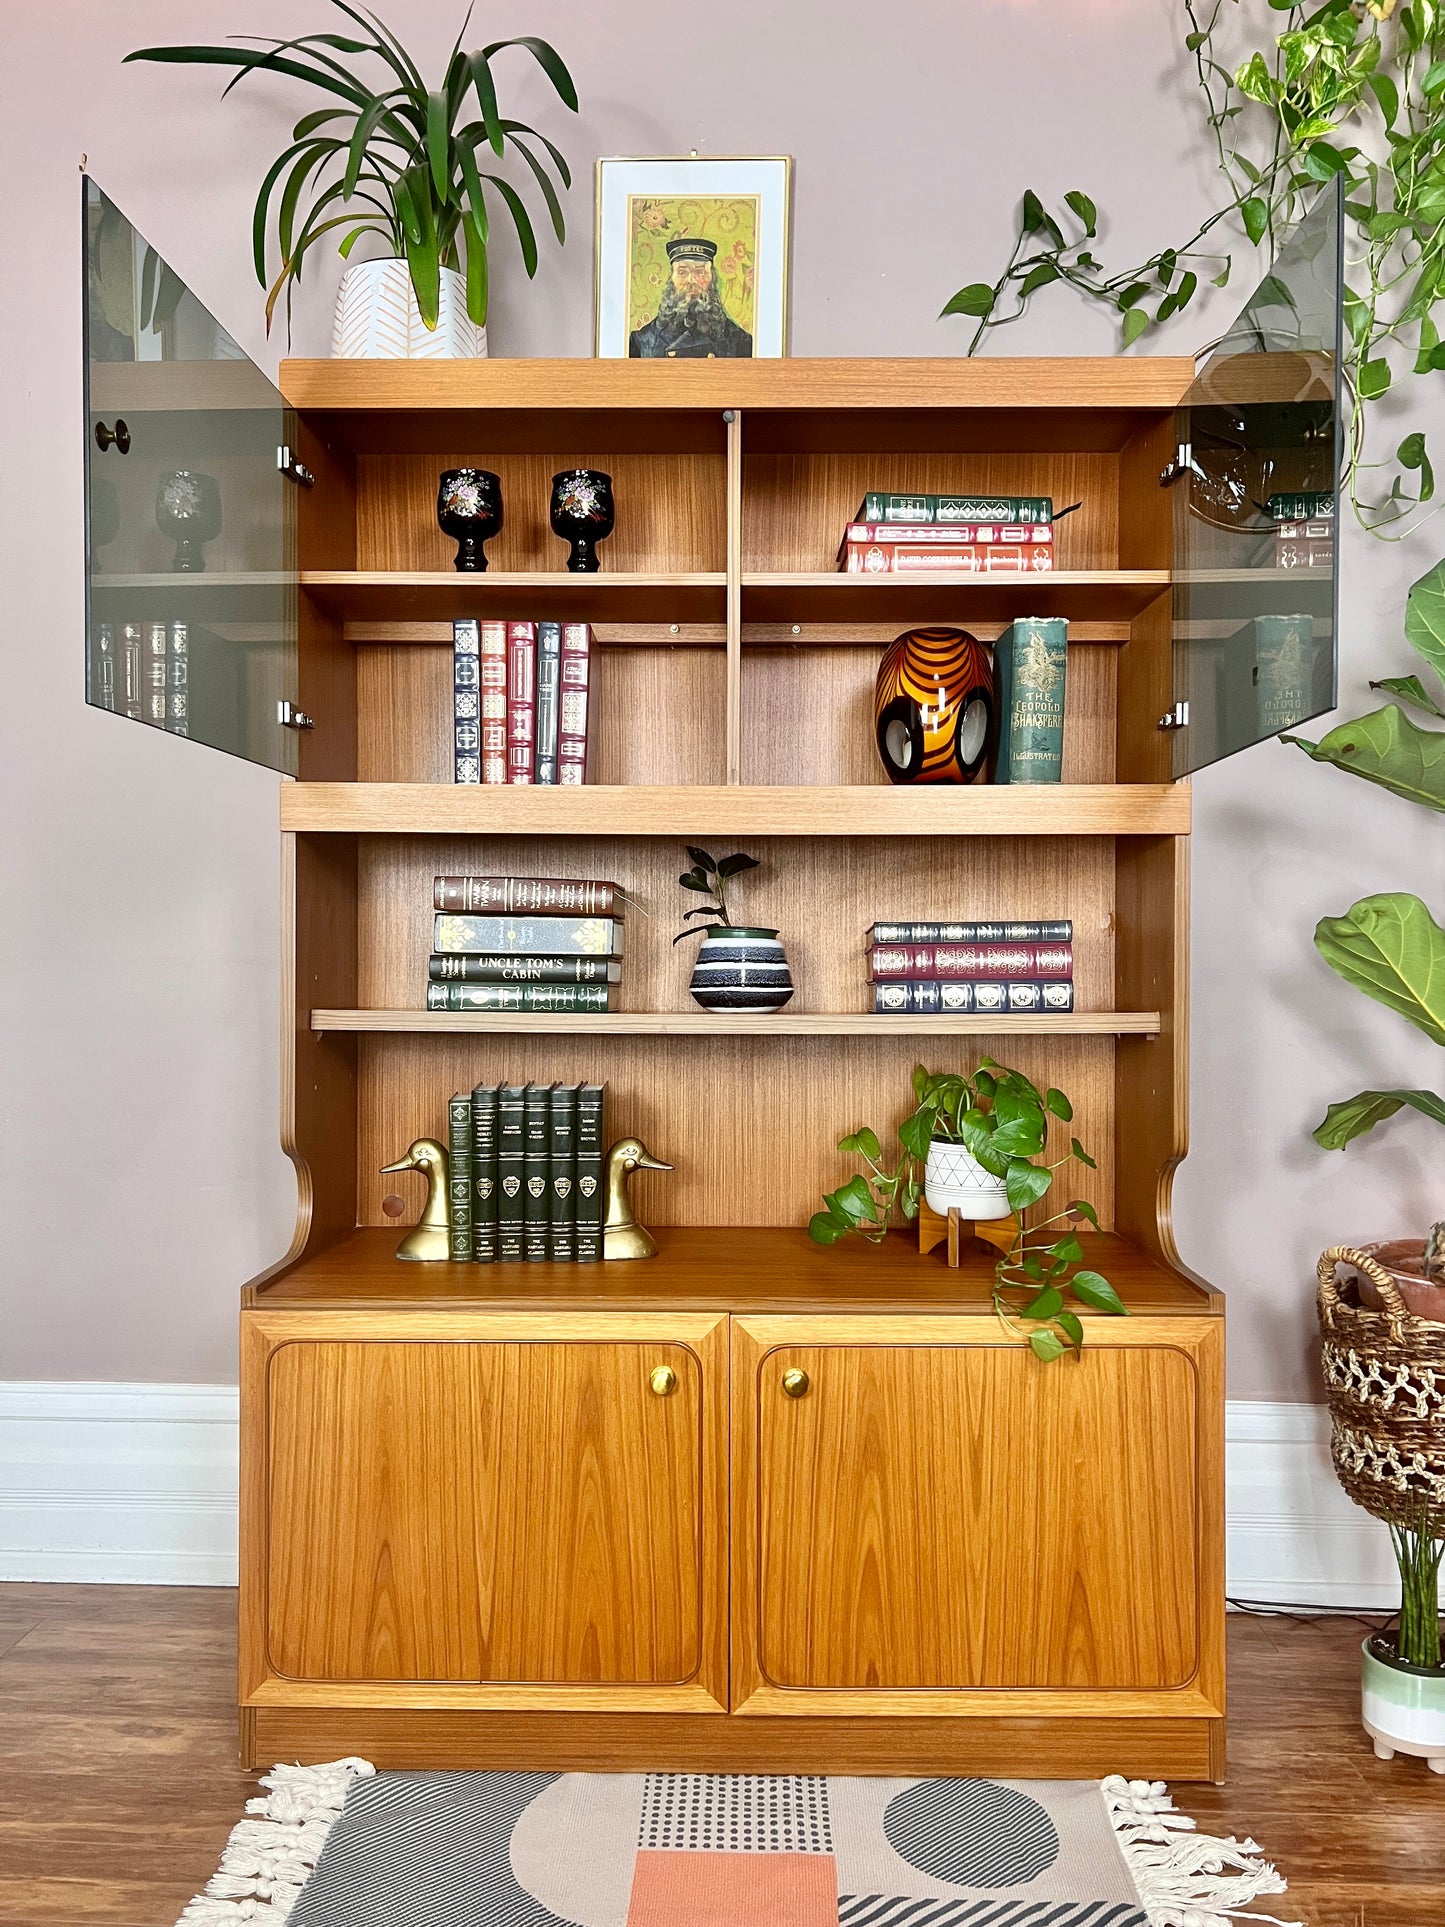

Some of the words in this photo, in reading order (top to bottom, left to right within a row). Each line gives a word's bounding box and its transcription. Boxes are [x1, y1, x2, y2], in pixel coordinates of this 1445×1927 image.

[1026, 692, 1054, 702] THE
[1016, 700, 1060, 713] LEOPOLD
[1014, 713, 1062, 730] SHAKSPERE
[1013, 751, 1060, 760] ILLUSTRATED
[480, 880, 490, 906] TWAIN
[478, 958, 521, 968] UNCLE
[526, 958, 564, 968] TOM'S
[502, 969, 541, 978] CABIN
